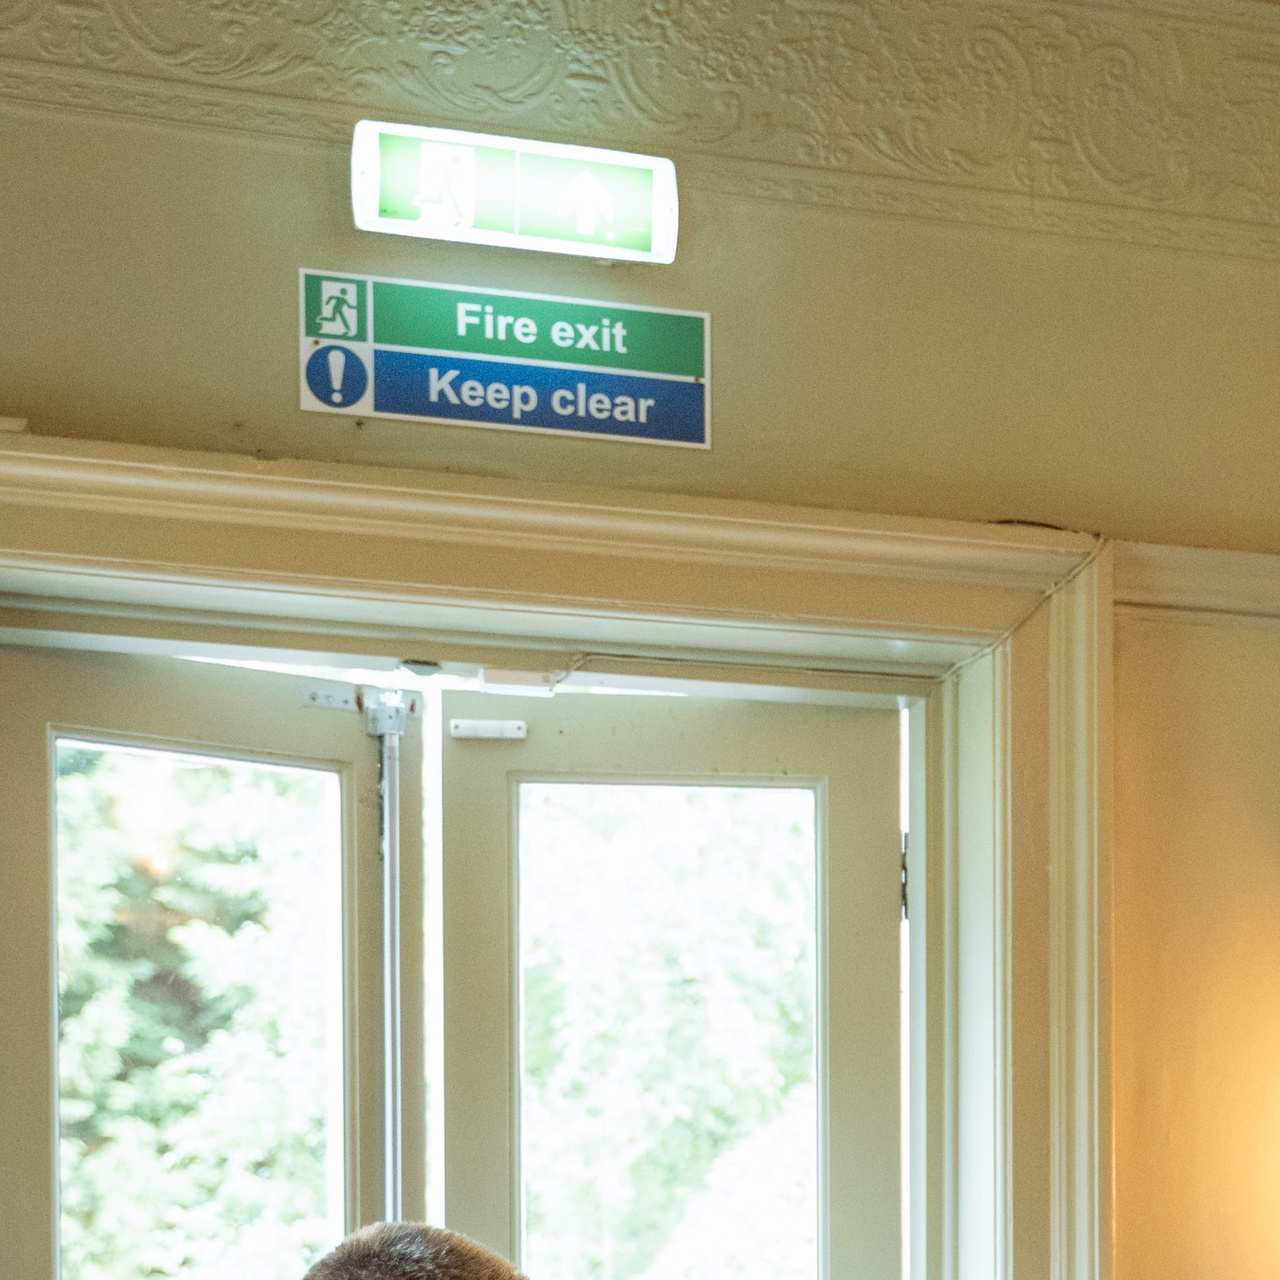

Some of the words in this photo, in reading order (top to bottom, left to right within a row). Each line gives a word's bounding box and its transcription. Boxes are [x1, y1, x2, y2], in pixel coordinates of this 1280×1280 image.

[456, 302, 538, 344] Fire
[551, 317, 628, 354] exit
[428, 367, 538, 420] Keep
[551, 383, 656, 424] clear
